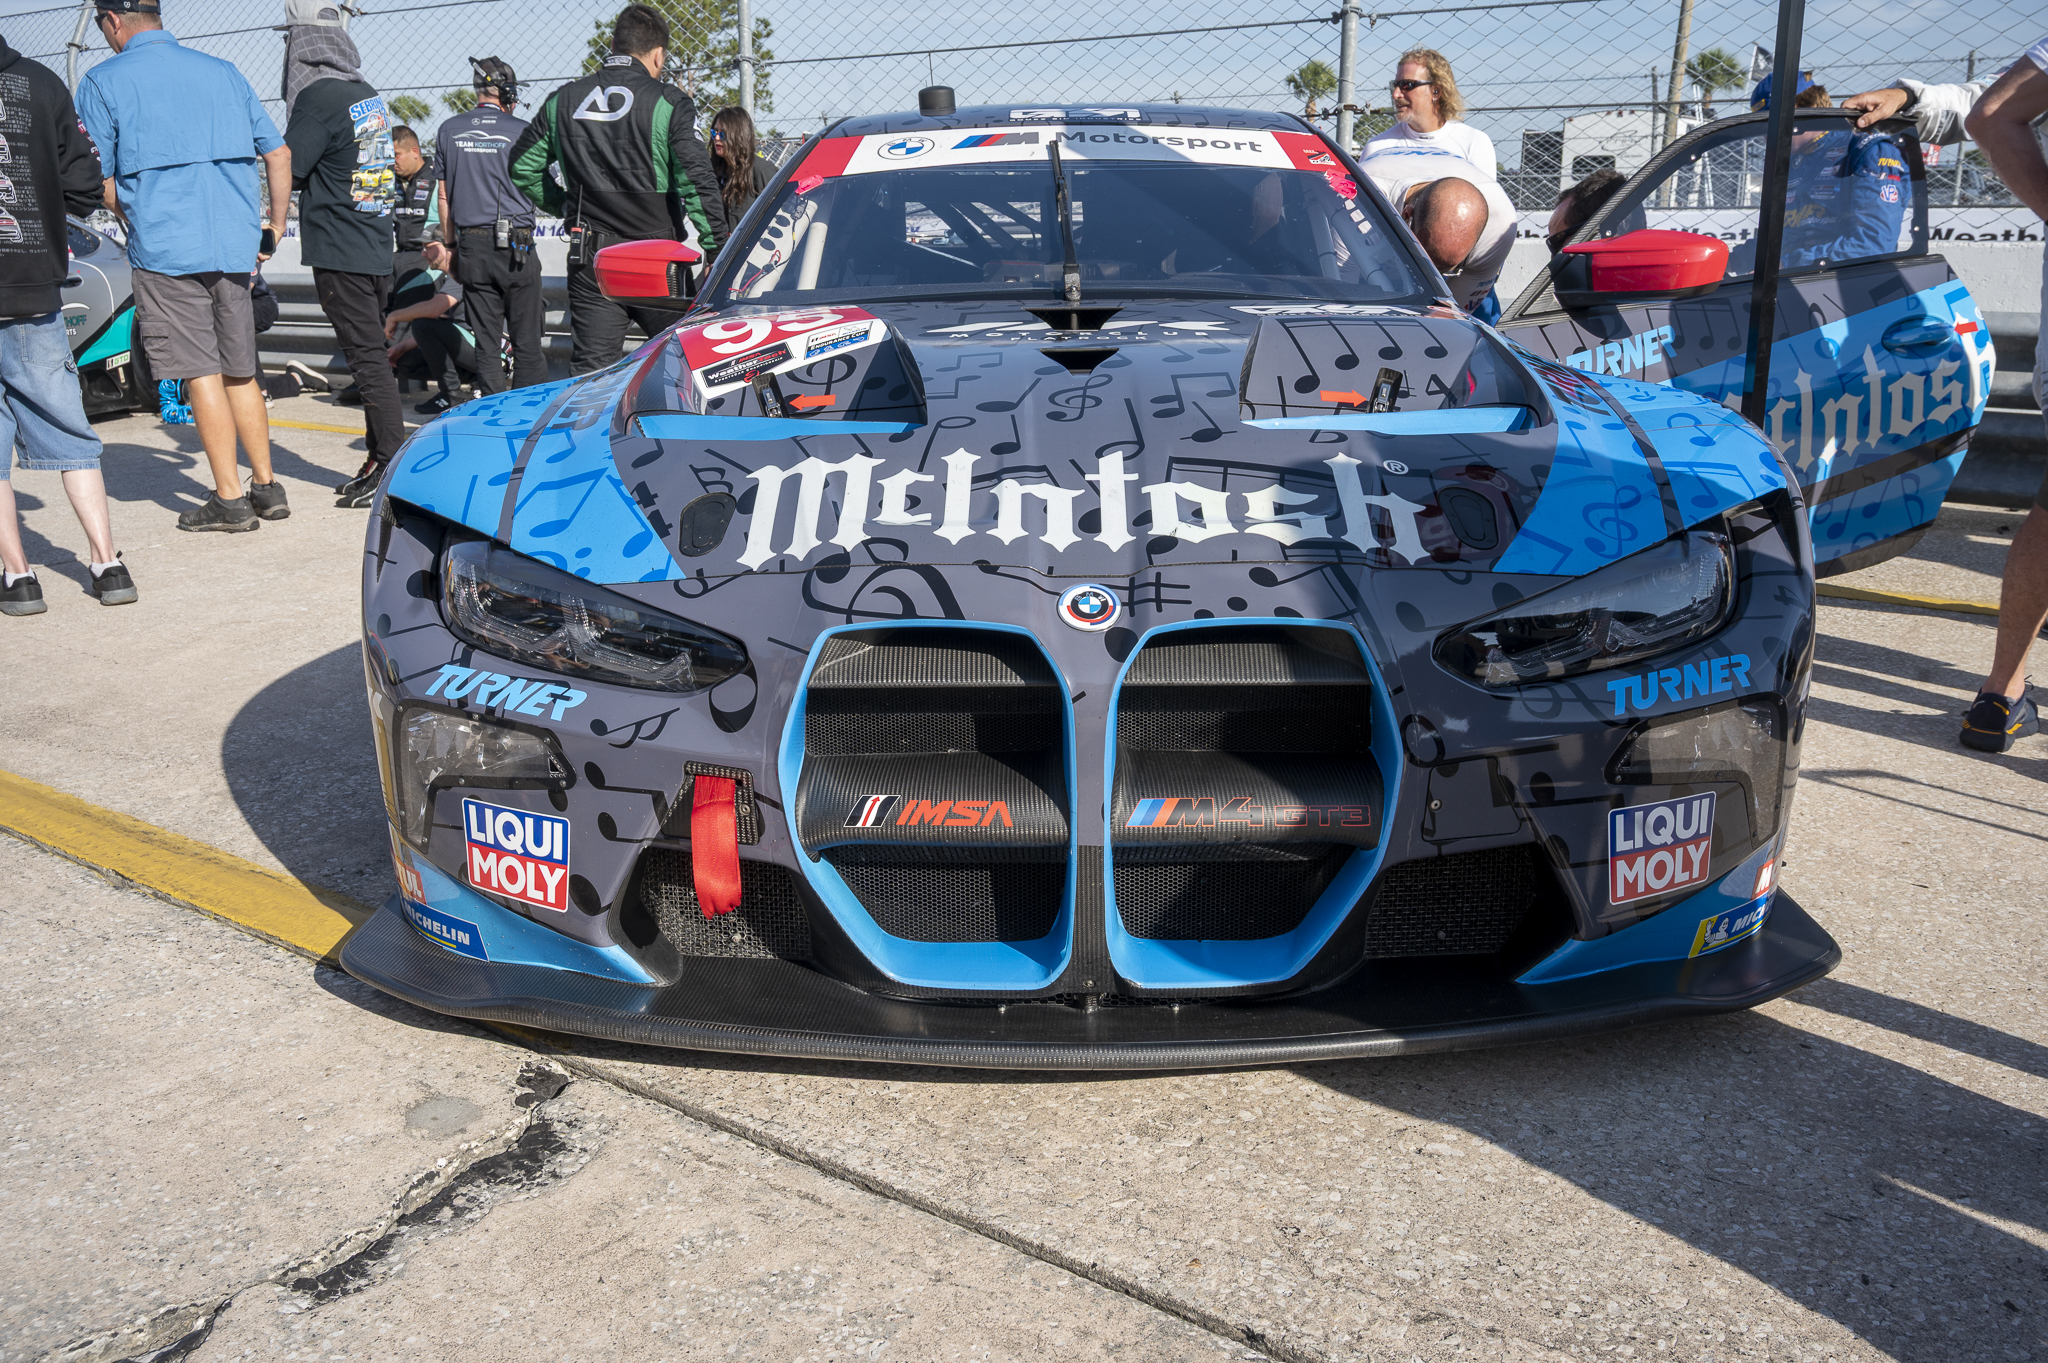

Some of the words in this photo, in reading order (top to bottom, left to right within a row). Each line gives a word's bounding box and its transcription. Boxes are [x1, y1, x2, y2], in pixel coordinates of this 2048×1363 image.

[1056, 132, 1262, 152] Motorsport
[703, 309, 844, 354] 95
[811, 335, 850, 350] ENDURANCE
[114, 354, 129, 365] GTD
[1768, 312, 1996, 473] cIntosh
[736, 447, 1434, 572] McIntosh
[425, 664, 588, 721] TURNER
[1607, 653, 1751, 716] TURNER
[468, 804, 563, 860] LIQUI
[896, 800, 1013, 827] IMSA
[1164, 797, 1264, 827] M4
[1274, 805, 1371, 827] GT3
[1615, 798, 1710, 852] LIQUI
[471, 846, 566, 904] MOLY
[1616, 840, 1709, 898] MOLY
[405, 904, 470, 946] MICHELIN
